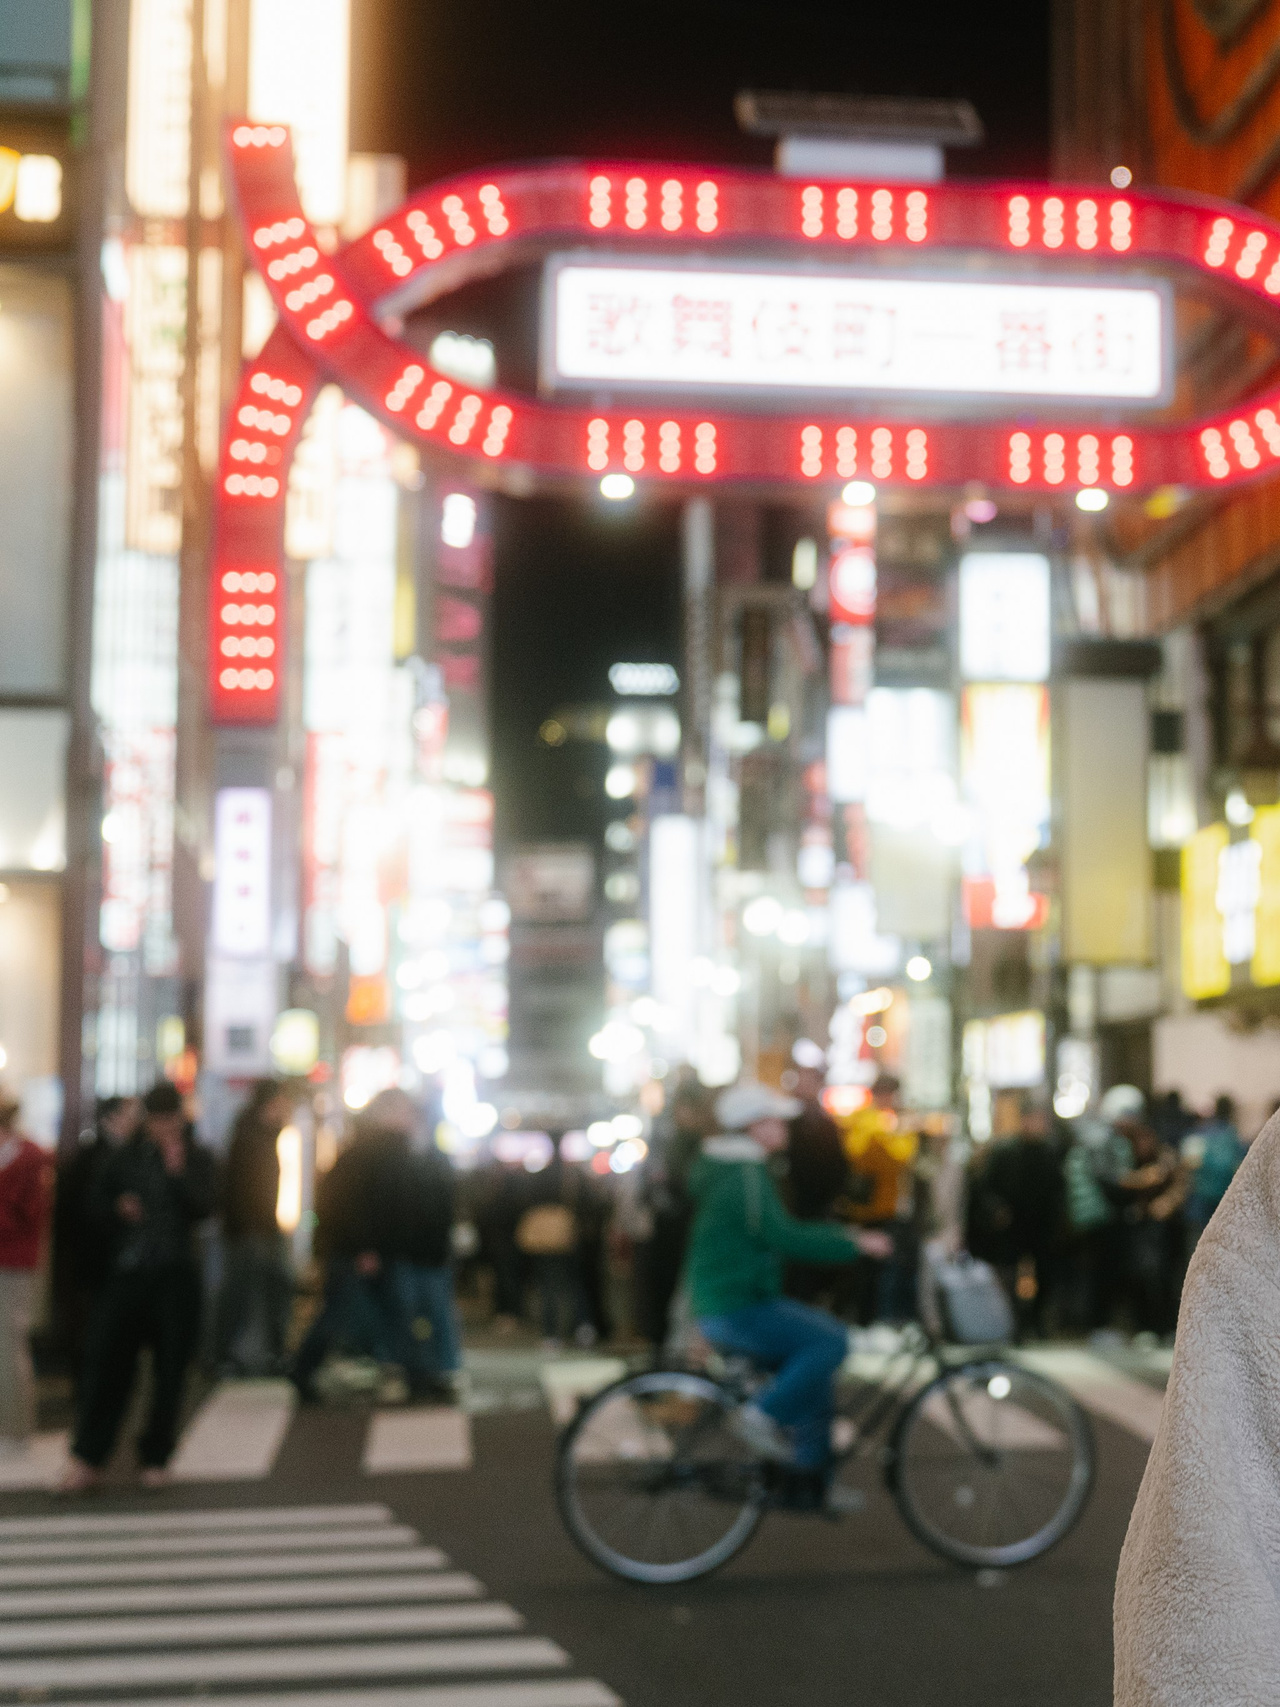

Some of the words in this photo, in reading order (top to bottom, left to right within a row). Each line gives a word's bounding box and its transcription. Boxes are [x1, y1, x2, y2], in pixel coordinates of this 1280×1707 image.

[588, 292, 1137, 376] 歌舞伎町一番街
